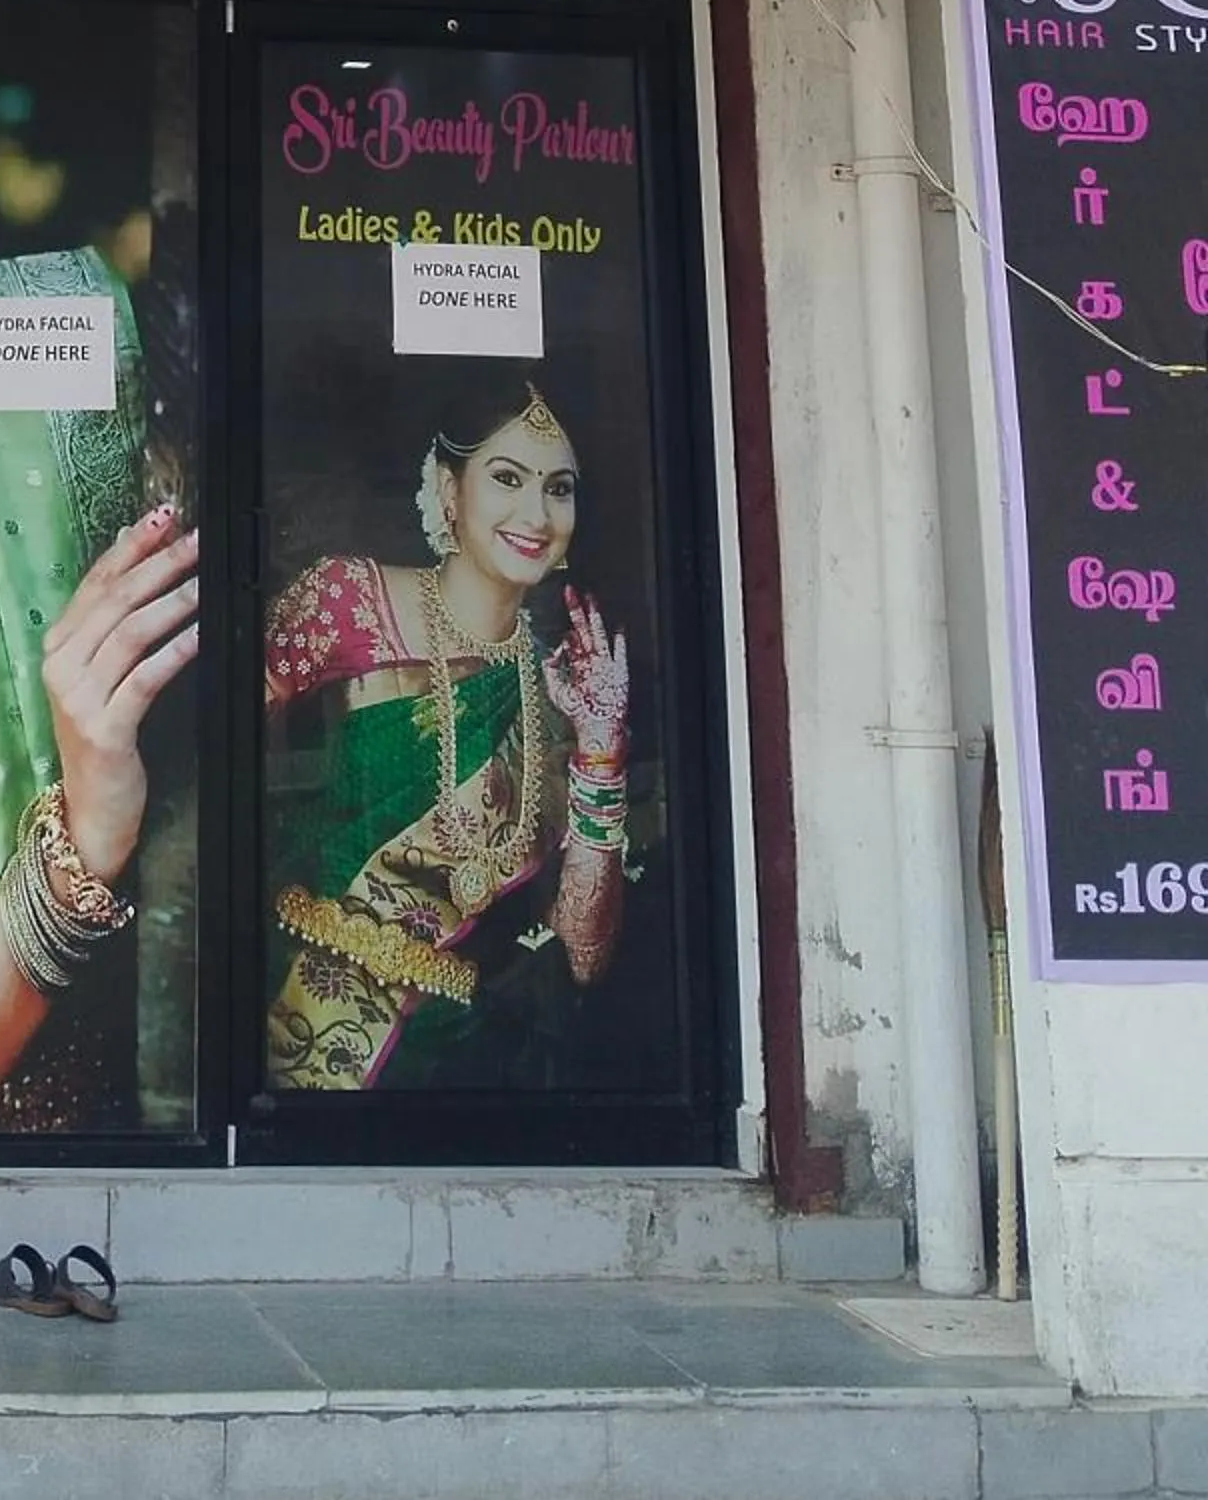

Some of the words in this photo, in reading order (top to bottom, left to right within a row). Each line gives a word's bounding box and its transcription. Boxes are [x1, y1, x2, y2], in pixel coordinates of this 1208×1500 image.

[1004, 18, 1105, 49] HAIR
[1135, 24, 1207, 52] STY
[283, 84, 356, 174] Sri
[362, 88, 494, 183] Beauty
[501, 92, 634, 171] Parlour
[298, 205, 399, 243] Ladies
[411, 210, 442, 244] &
[454, 212, 522, 246] Kids
[532, 216, 601, 253] Only
[413, 263, 464, 277] HYDRA
[468, 264, 520, 279] FACIAL
[419, 290, 468, 307] DONE
[474, 292, 517, 309] HERE
[40, 316, 94, 331] FACIAL
[45, 345, 90, 361] HERE
[1091, 459, 1140, 512] &
